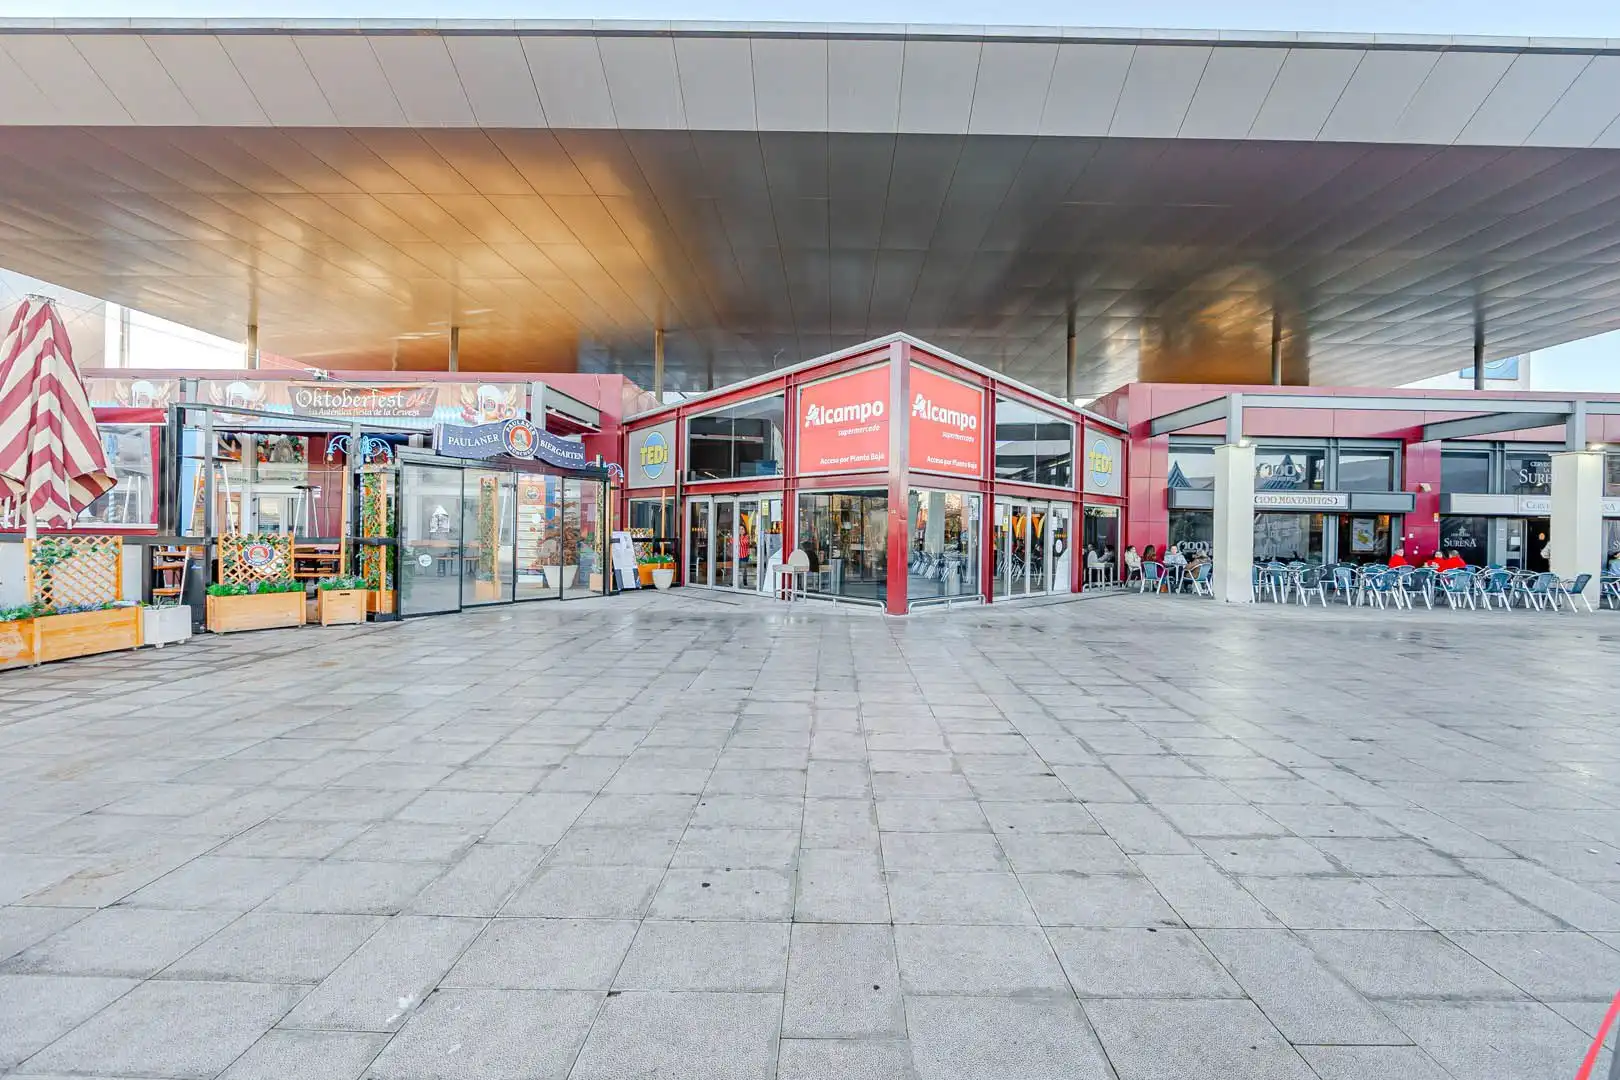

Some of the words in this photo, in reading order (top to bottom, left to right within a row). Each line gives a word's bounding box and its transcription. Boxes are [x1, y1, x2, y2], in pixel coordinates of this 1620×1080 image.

[295, 388, 404, 409] Oktoberfest
[805, 400, 884, 428] Alcampo
[912, 393, 977, 430] Alcampo
[448, 433, 500, 448] PAULANER
[540, 440, 584, 460] BIERGARTEN
[840, 456, 850, 465] por
[1519, 468, 1552, 484] SURE
